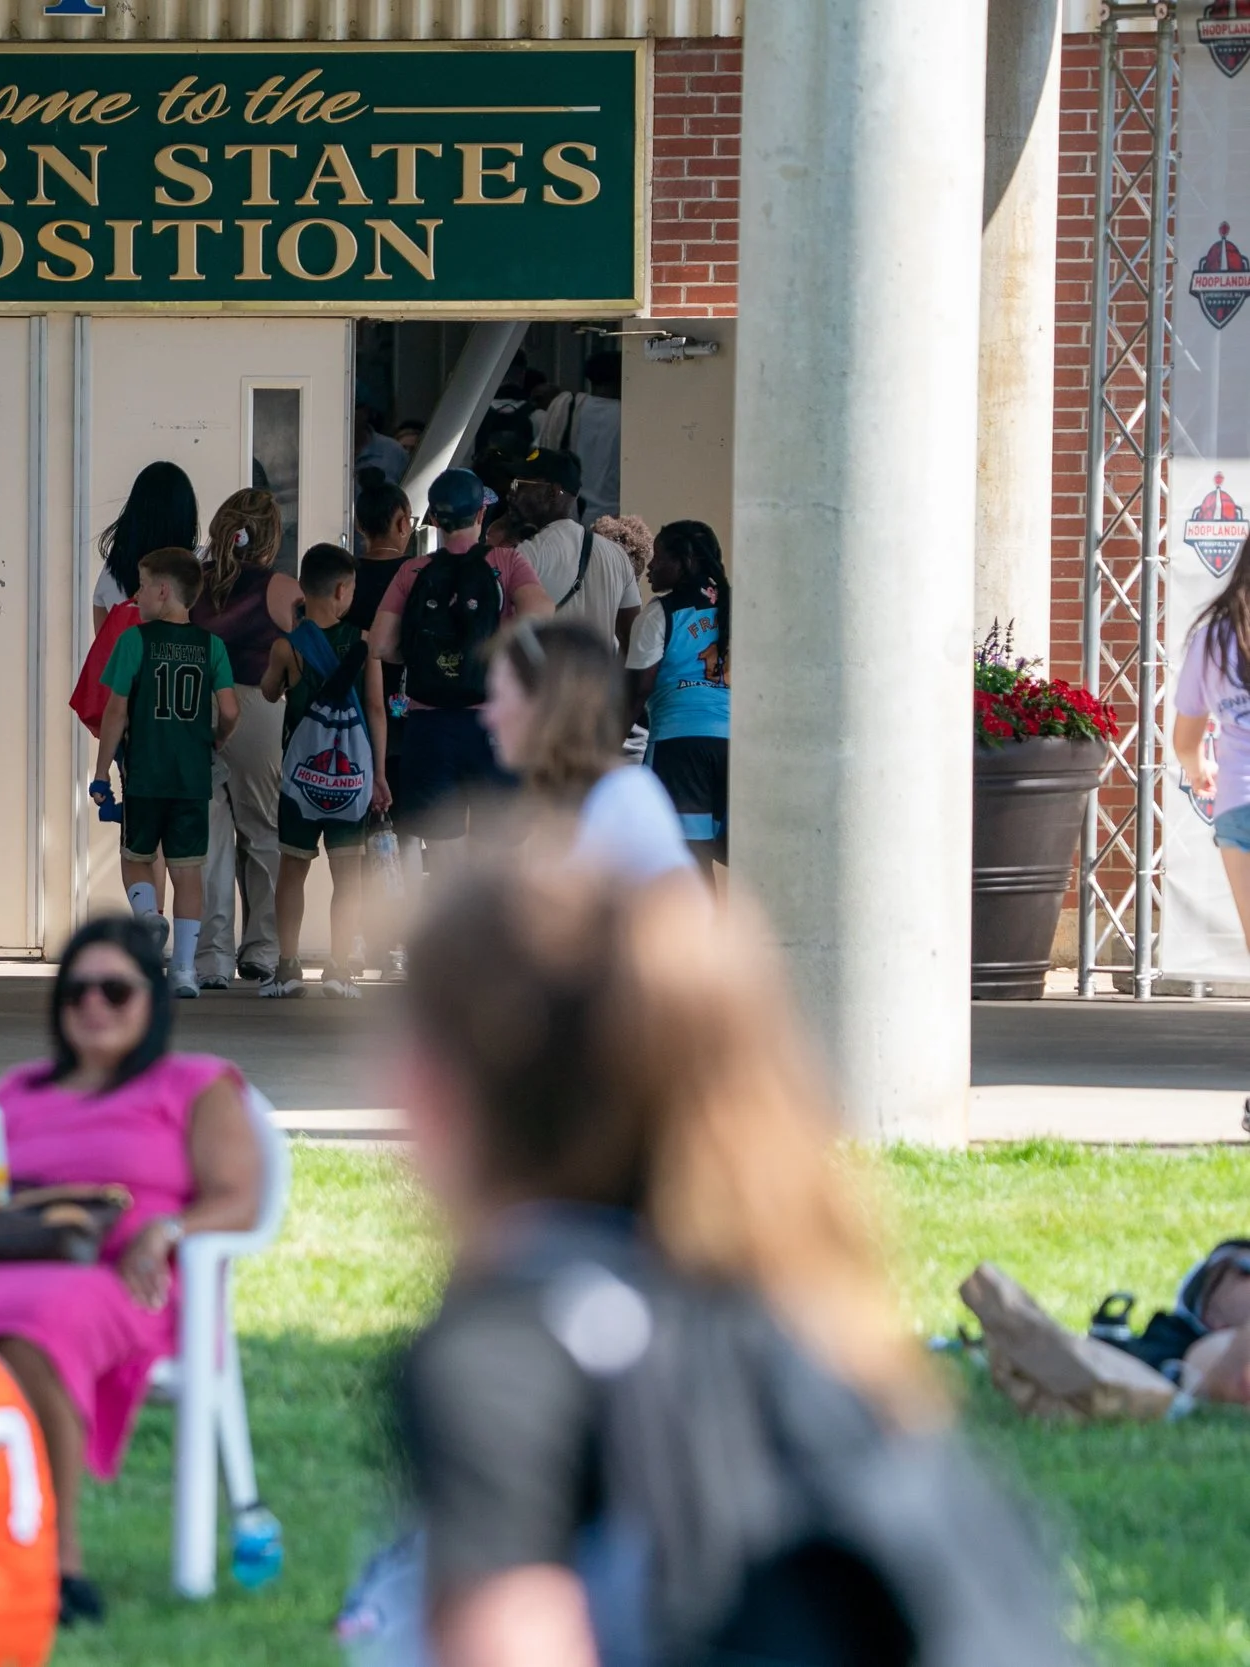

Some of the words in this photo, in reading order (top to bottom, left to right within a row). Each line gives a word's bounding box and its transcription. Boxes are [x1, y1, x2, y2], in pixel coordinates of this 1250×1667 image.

[157, 75, 230, 125] to
[243, 68, 367, 125] the
[154, 141, 601, 207] STATES
[1187, 525, 1247, 537] HOOPLANDIA
[150, 642, 206, 663] LANGEVIN
[154, 661, 203, 721] 10
[297, 768, 363, 788] HOOPLANDIA
